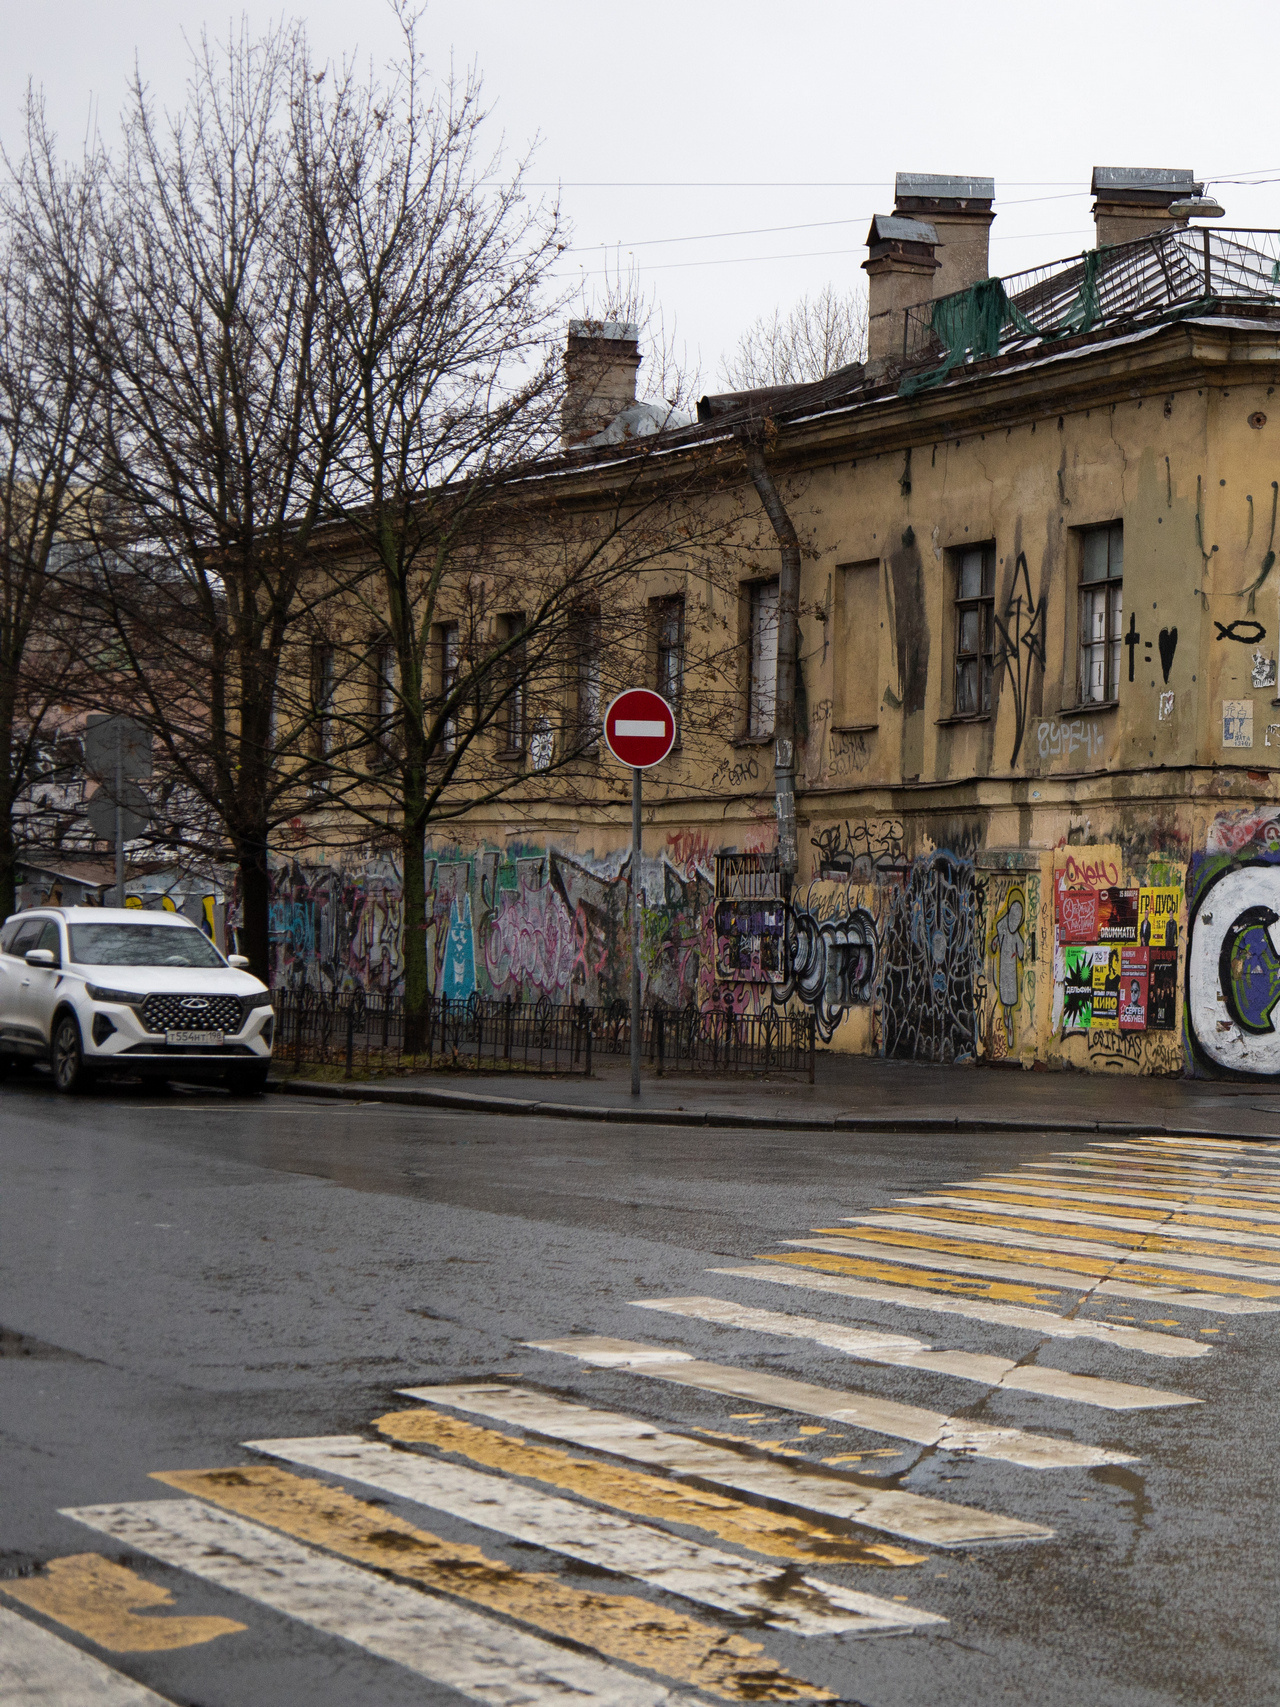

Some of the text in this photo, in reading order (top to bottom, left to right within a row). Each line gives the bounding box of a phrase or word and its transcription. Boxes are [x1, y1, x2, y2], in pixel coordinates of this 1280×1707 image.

[1140, 893, 1178, 916] ГРАДУСЫ
[1100, 927, 1136, 939] DRUMMATIX
[1066, 986, 1091, 995] ДЕЛЬФИН
[1093, 996, 1118, 1010] КИНО
[1125, 1006, 1145, 1015] СЕРГЕЙ
[1120, 1014, 1145, 1024] БОБУНЕЦ
